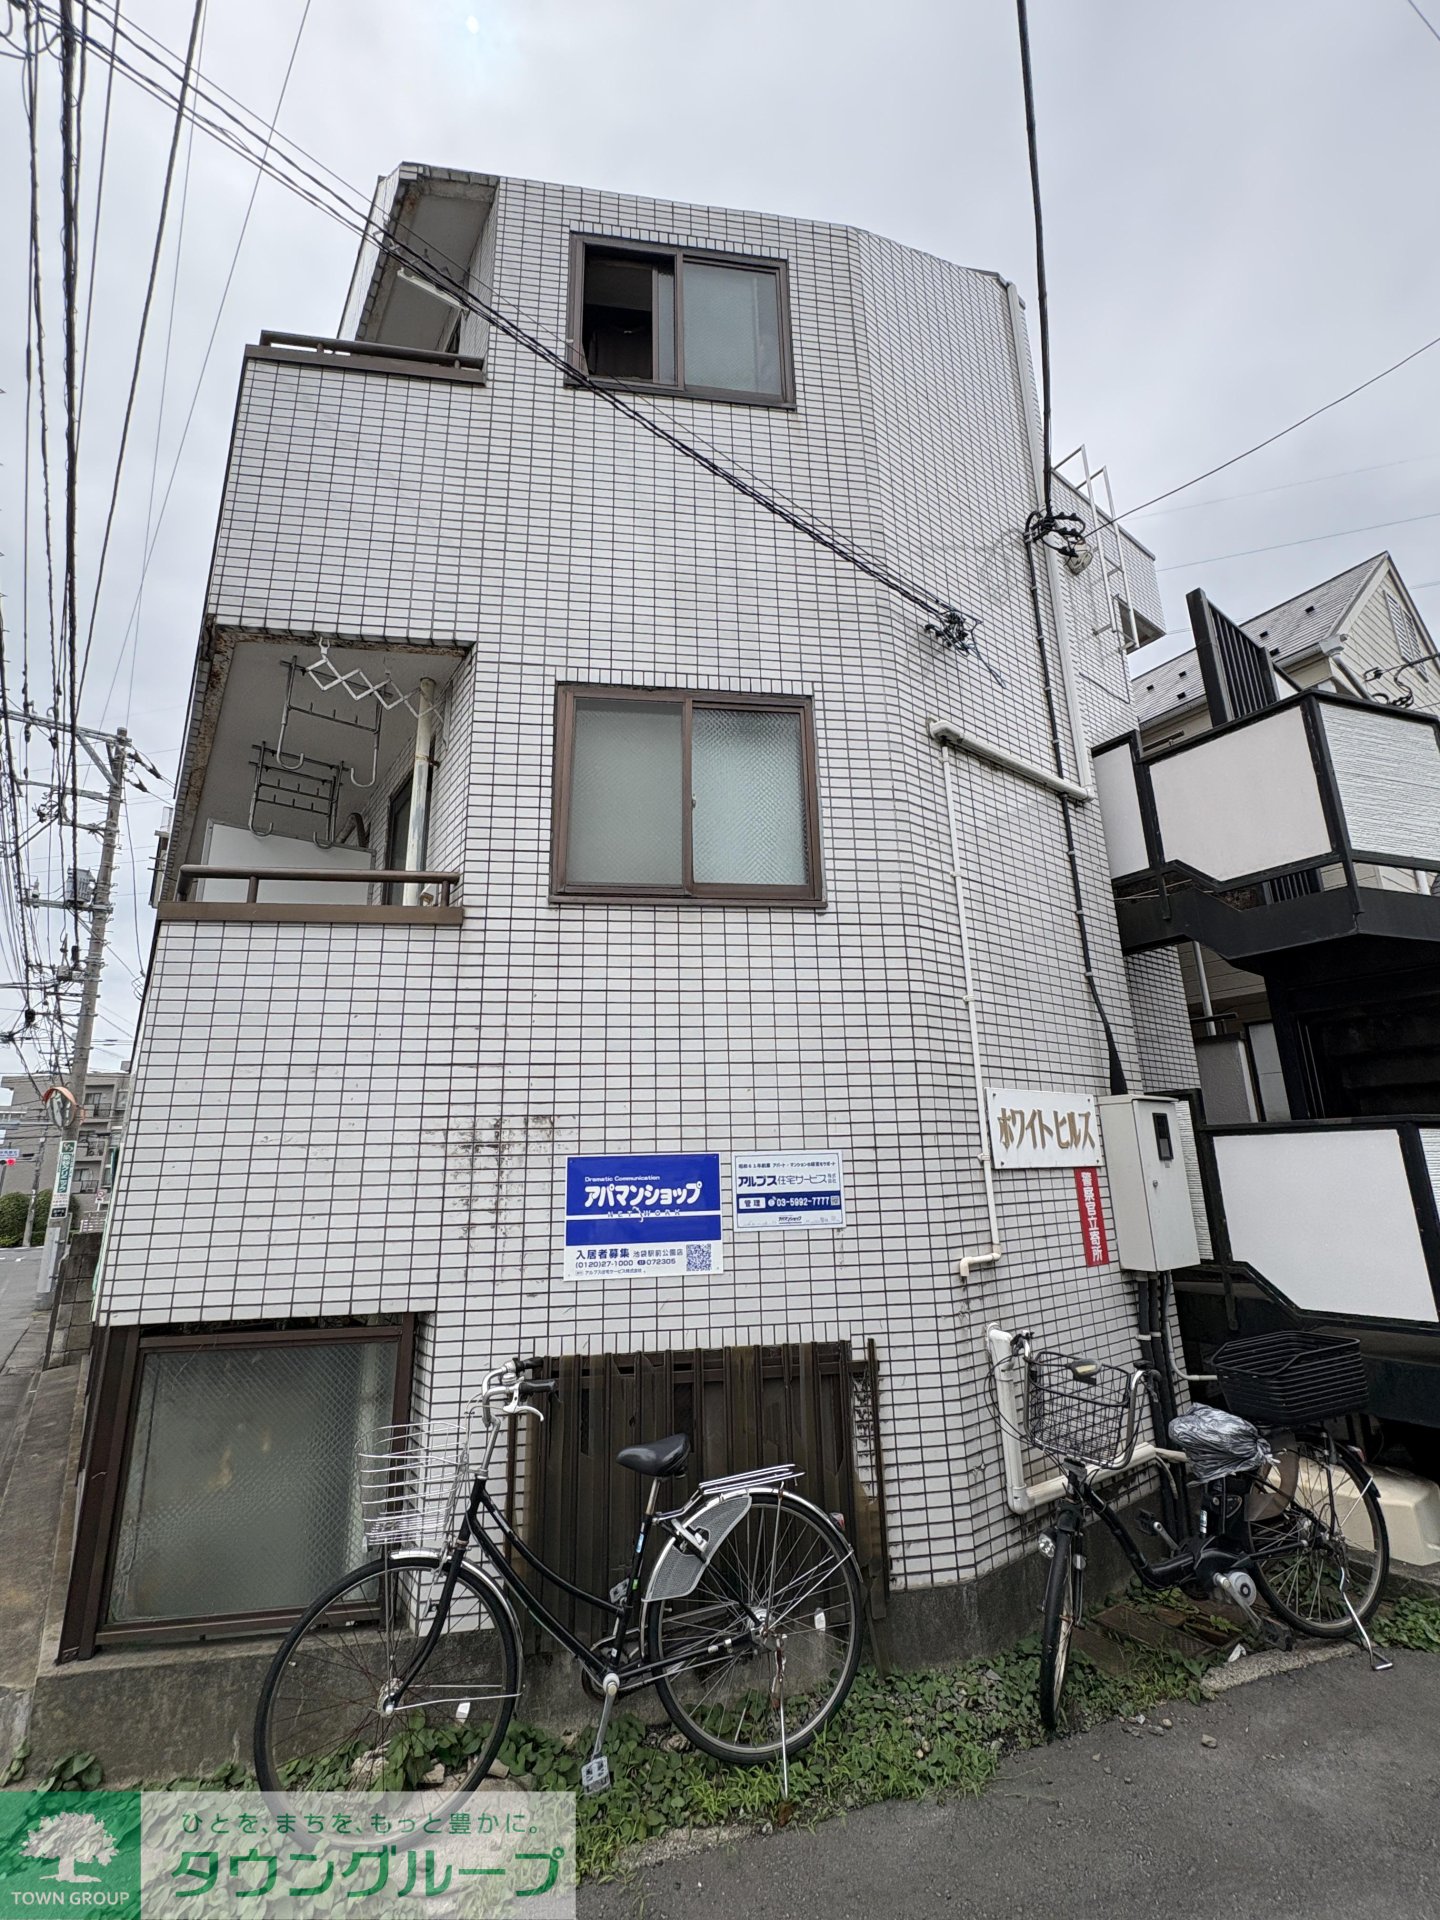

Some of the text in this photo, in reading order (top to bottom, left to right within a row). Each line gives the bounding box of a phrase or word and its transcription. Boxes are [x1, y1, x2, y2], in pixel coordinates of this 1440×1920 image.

[738, 1174, 827, 1187] アルプス住宅サービス
[584, 1180, 702, 1208] アパマンショップ
[576, 1248, 630, 1260] 入居者募集
[575, 1259, 634, 1269] (0120)27-1000
